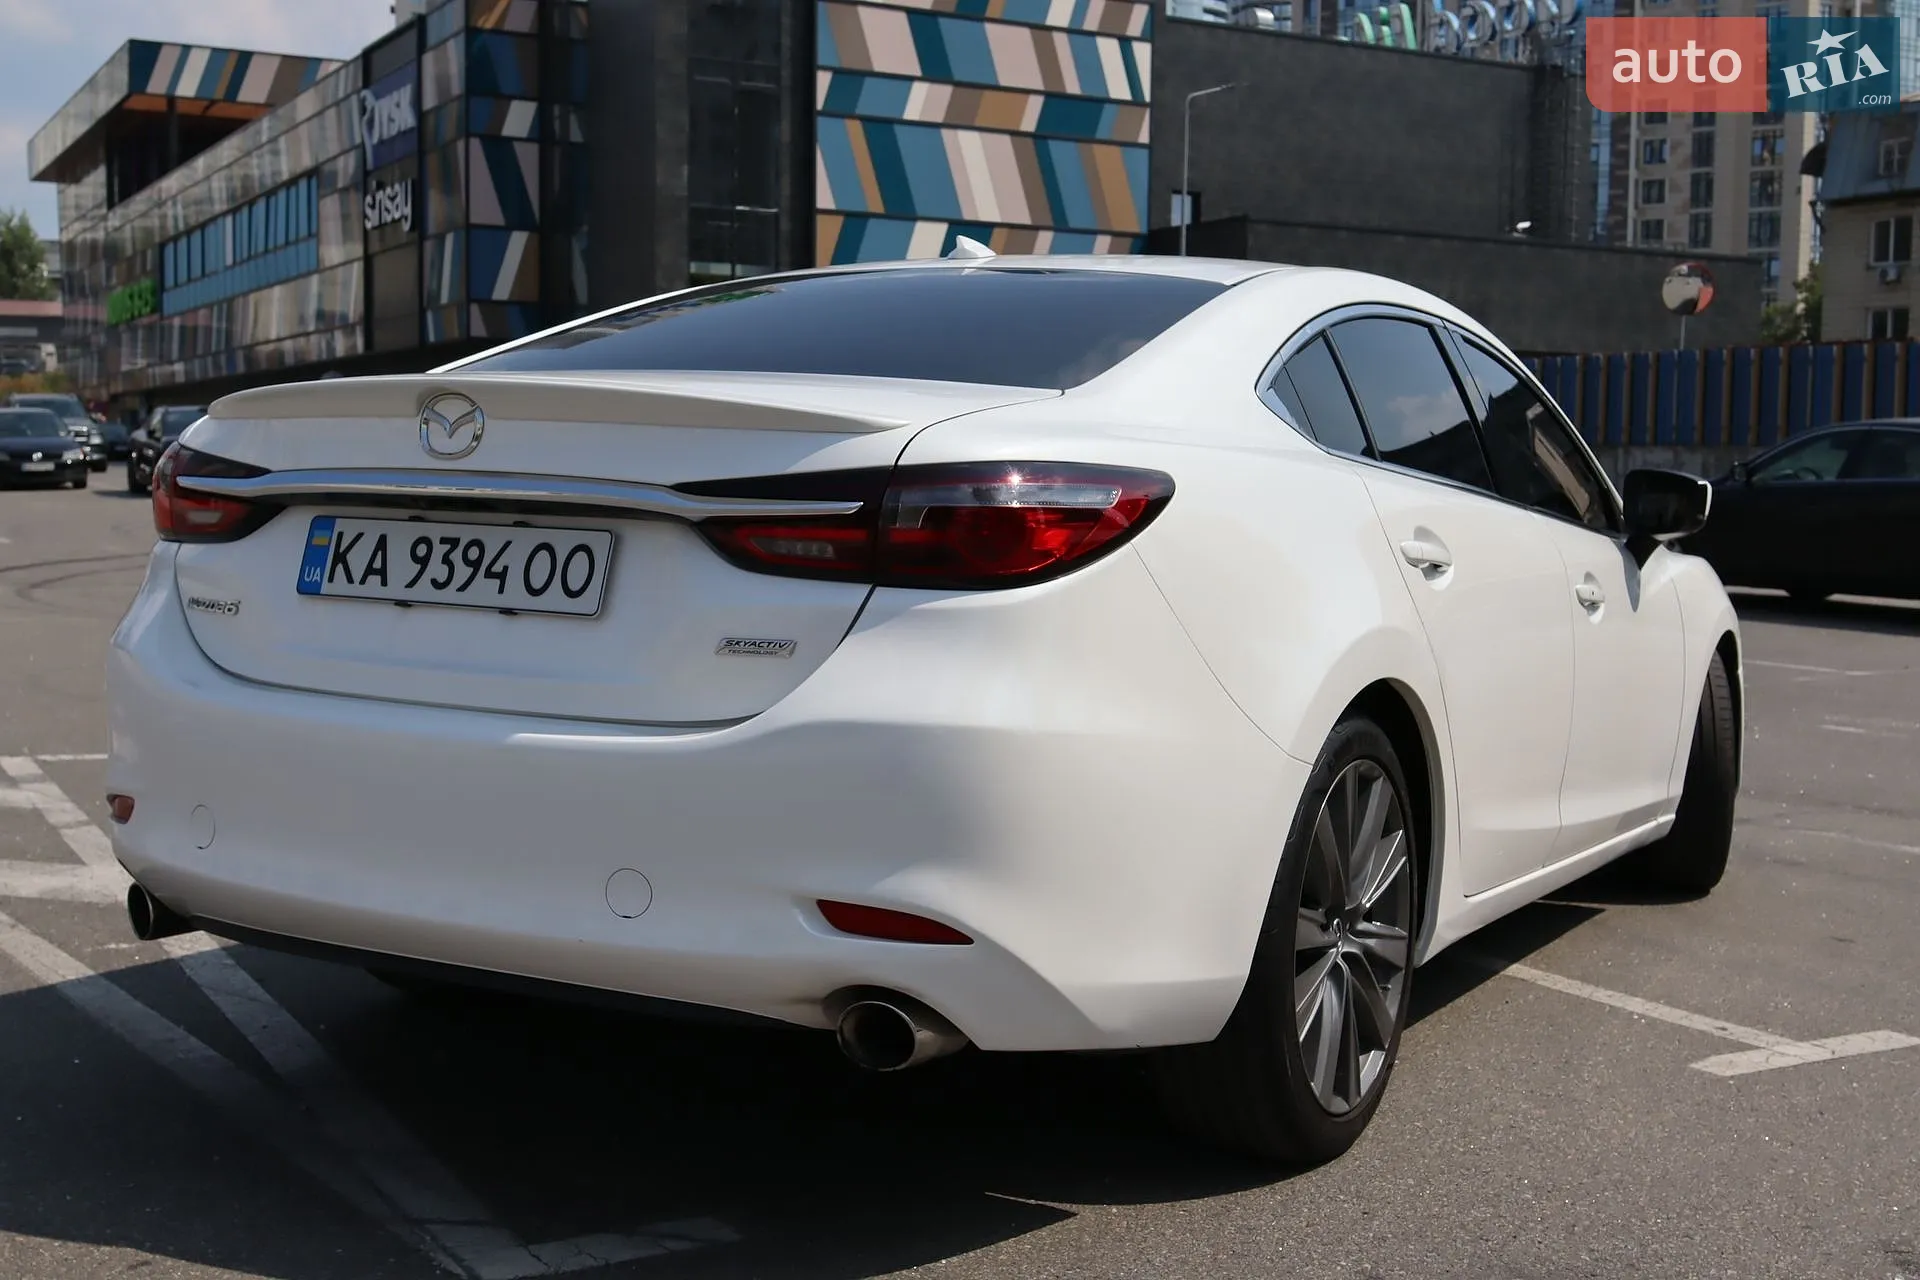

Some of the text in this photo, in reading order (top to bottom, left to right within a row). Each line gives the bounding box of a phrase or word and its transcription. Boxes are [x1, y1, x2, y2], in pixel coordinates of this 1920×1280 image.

[364, 178, 412, 232] sinsay
[303, 566, 321, 582] UA
[327, 531, 595, 599] KA 9394 OO
[723, 639, 788, 649] SKYACTIV
